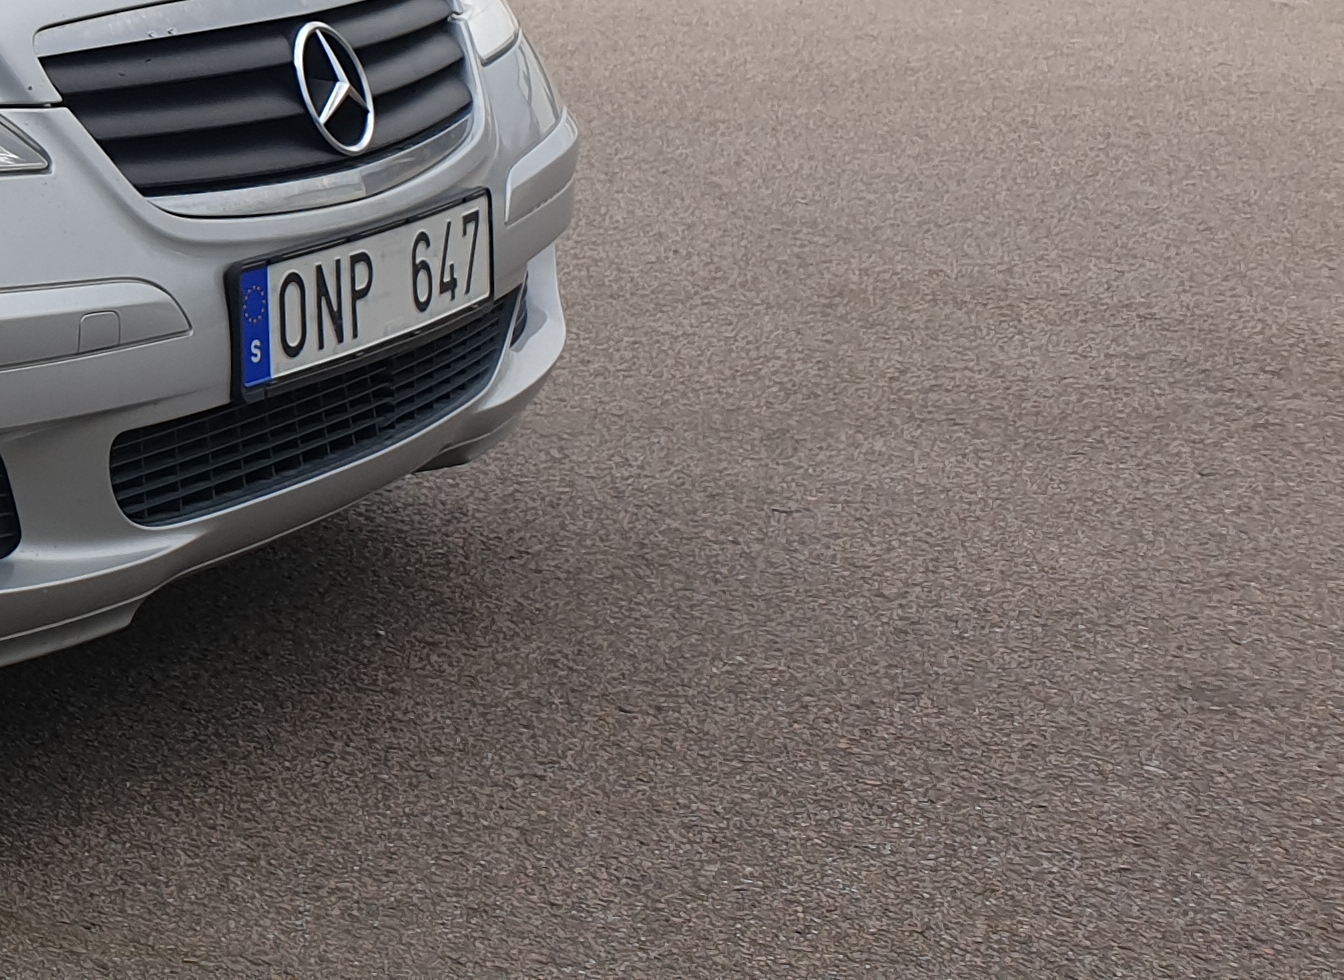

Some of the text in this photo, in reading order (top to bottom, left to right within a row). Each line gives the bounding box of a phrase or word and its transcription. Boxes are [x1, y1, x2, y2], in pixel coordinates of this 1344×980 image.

[250, 208, 480, 363] S ONP 647
